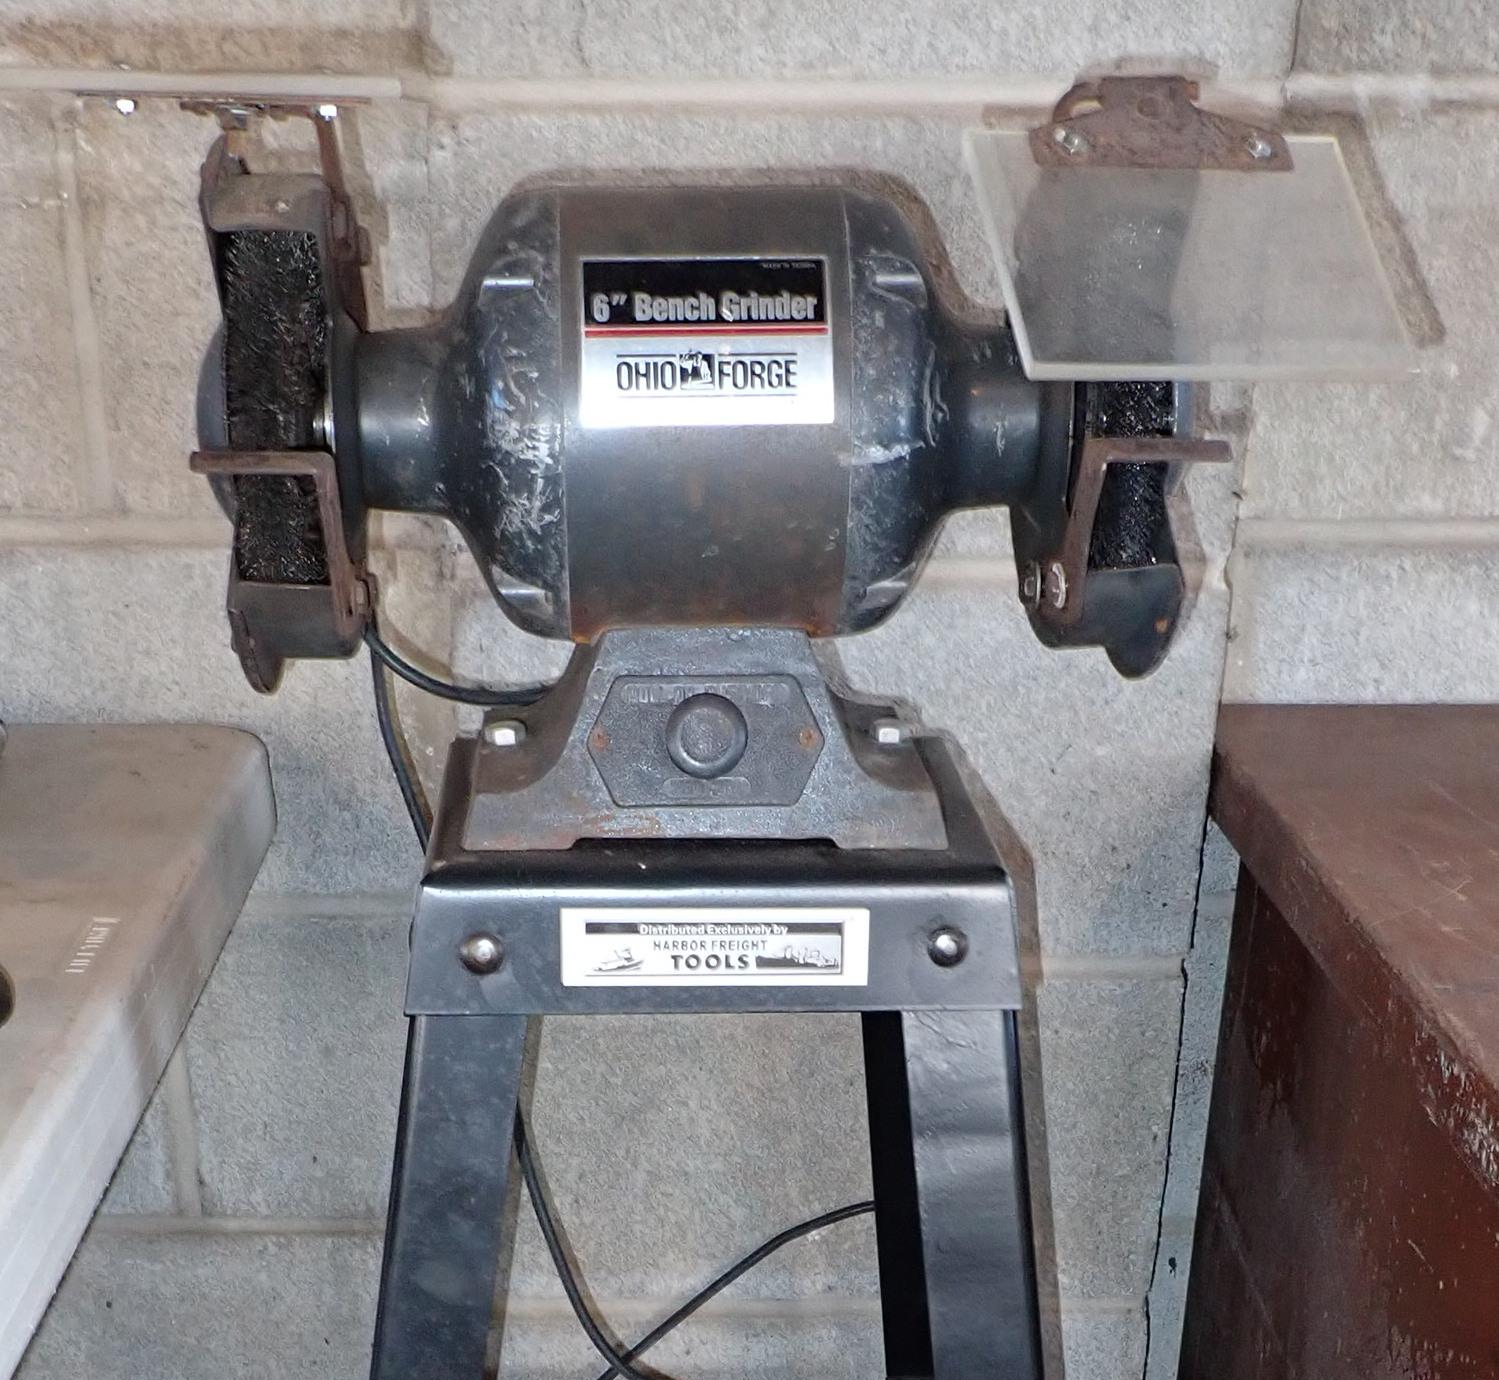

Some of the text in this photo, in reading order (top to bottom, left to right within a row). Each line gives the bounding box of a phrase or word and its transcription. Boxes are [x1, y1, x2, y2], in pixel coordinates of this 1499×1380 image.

[633, 291, 716, 322] Bench
[720, 290, 818, 322] Grinder
[616, 359, 798, 390] OHIO FORGE
[638, 923, 788, 936] Distributed Exclusively by
[653, 939, 768, 951] HARBOR FREIGHT
[671, 953, 751, 971] TOOLS
